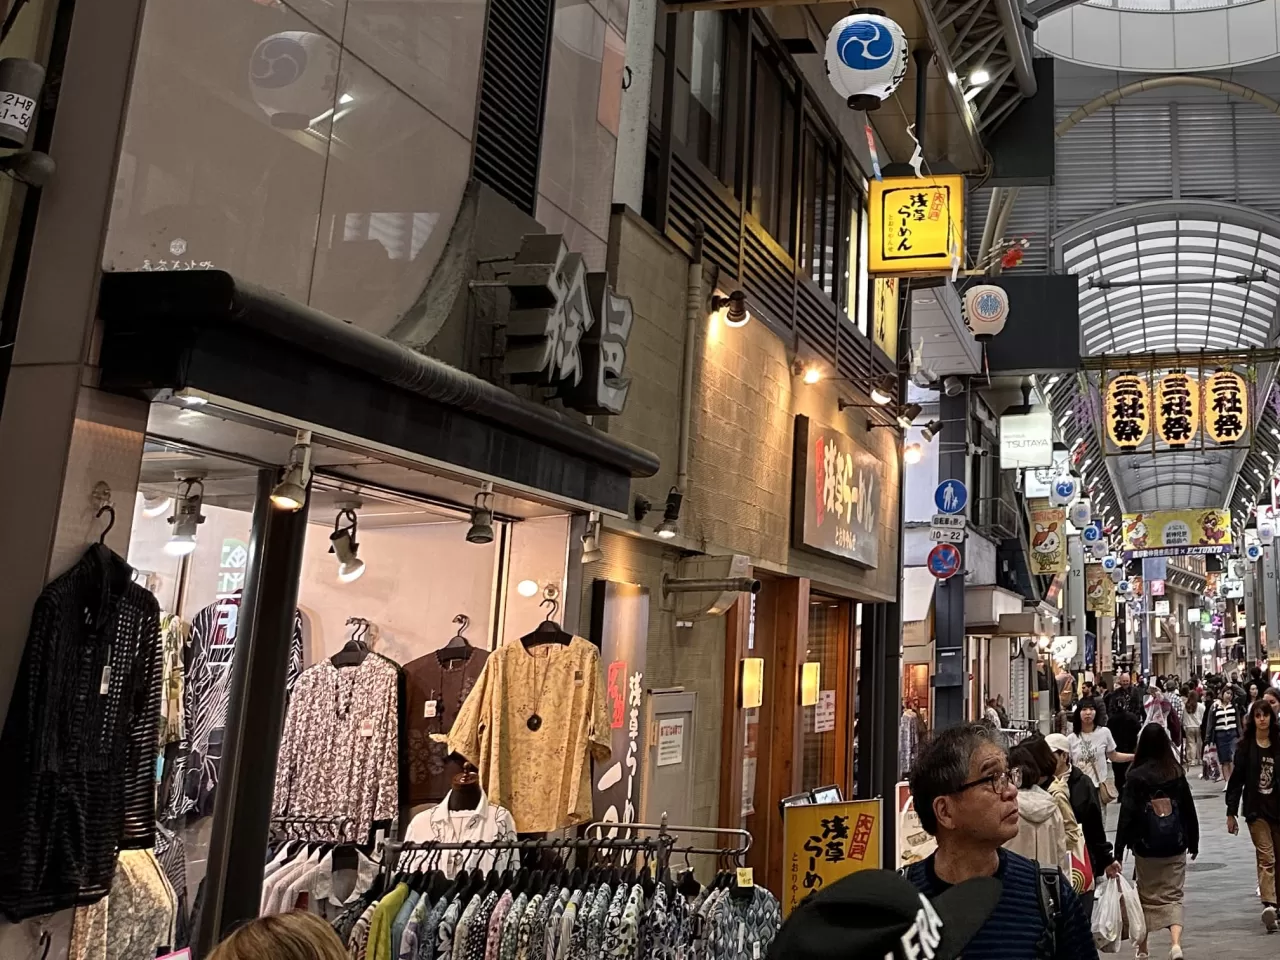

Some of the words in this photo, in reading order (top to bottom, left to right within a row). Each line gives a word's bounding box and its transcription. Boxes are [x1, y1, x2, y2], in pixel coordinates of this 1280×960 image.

[897, 205, 913, 252] らーめん
[909, 193, 929, 222] 浅草
[1112, 379, 1146, 441] 三社祭
[1160, 377, 1193, 441] 三社祭
[1211, 374, 1243, 438] 三社祭
[1007, 440, 1049, 449] TSUTAYA
[1073, 569, 1081, 577] 12
[1266, 571, 1274, 579] 12
[820, 815, 850, 863] 浅草
[849, 814, 873, 860] 大江戸
[803, 836, 823, 897] らーめ
